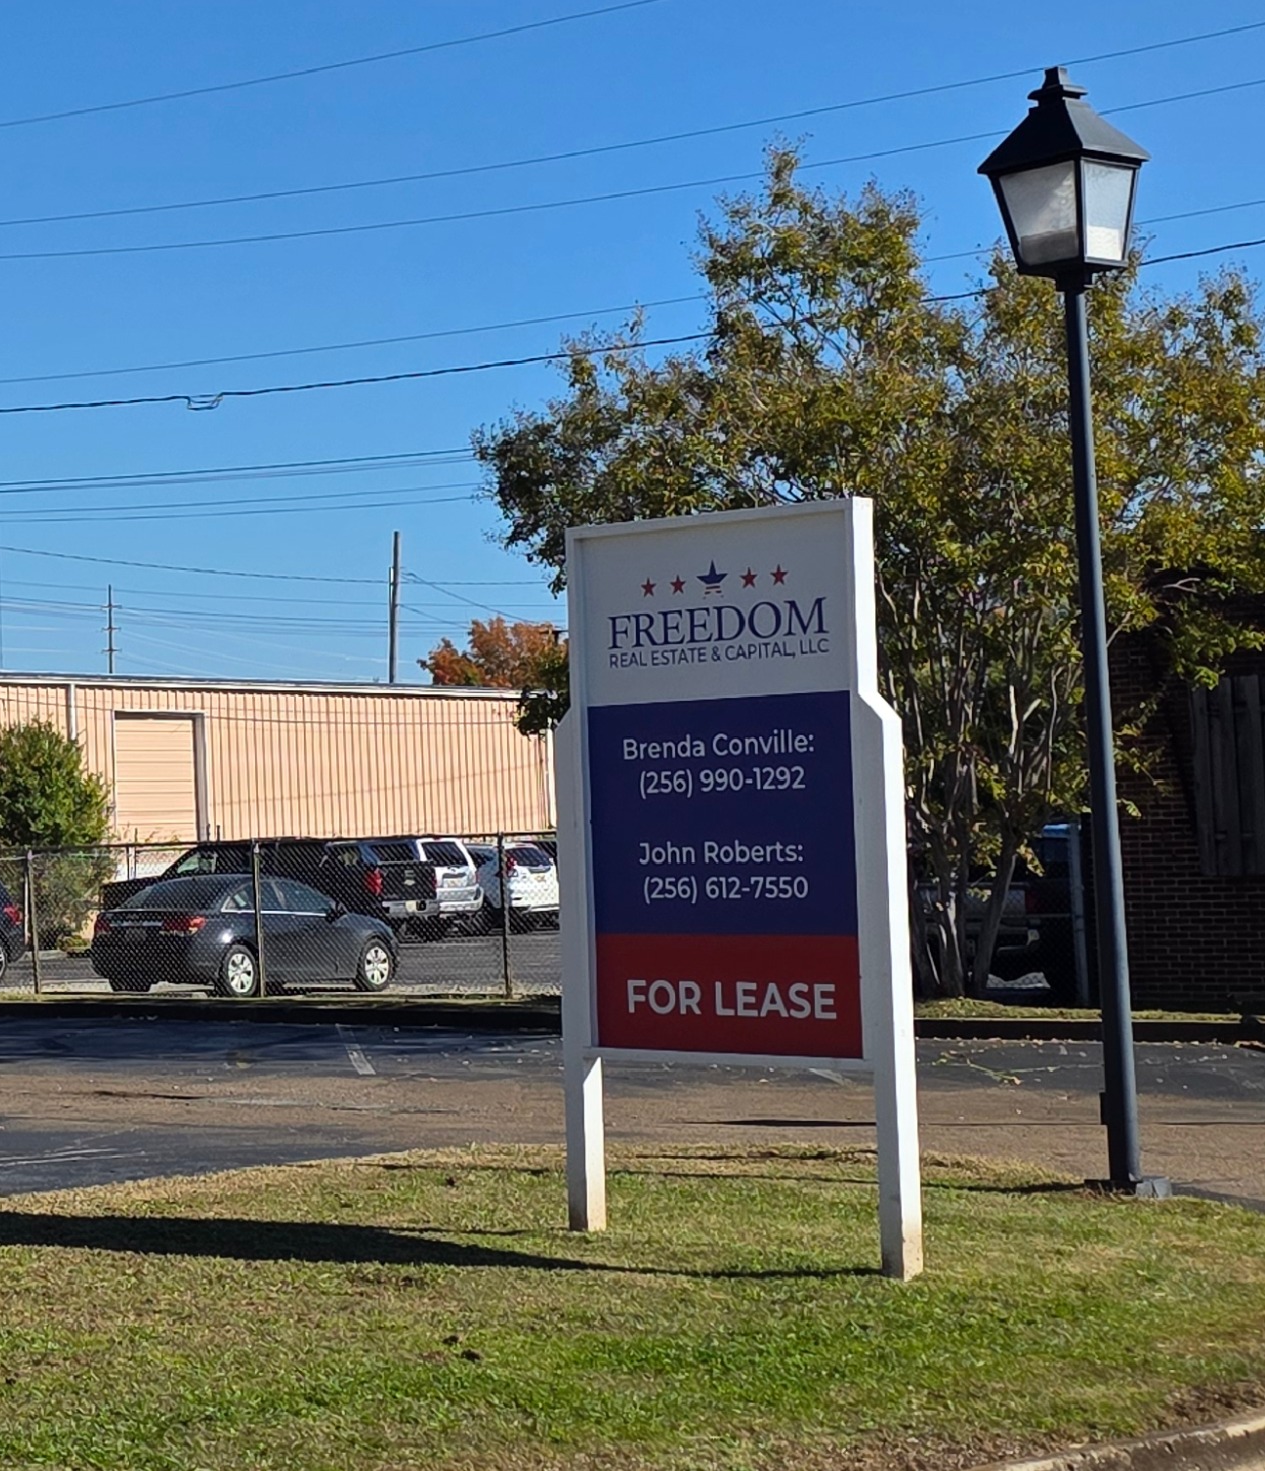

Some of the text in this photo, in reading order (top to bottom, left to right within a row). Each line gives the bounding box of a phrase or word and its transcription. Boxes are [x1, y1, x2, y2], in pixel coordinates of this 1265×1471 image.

[608, 597, 830, 649] FREEDOM
[609, 638, 831, 669] REAL ESTATE & CAPITAL, LLC
[623, 729, 815, 760] Brenda Conville:
[640, 765, 806, 799] (256) 990-1292
[639, 839, 804, 865] John Roberts:
[644, 876, 809, 904] (256) 612-7550
[627, 979, 837, 1019] FOR LEASE
